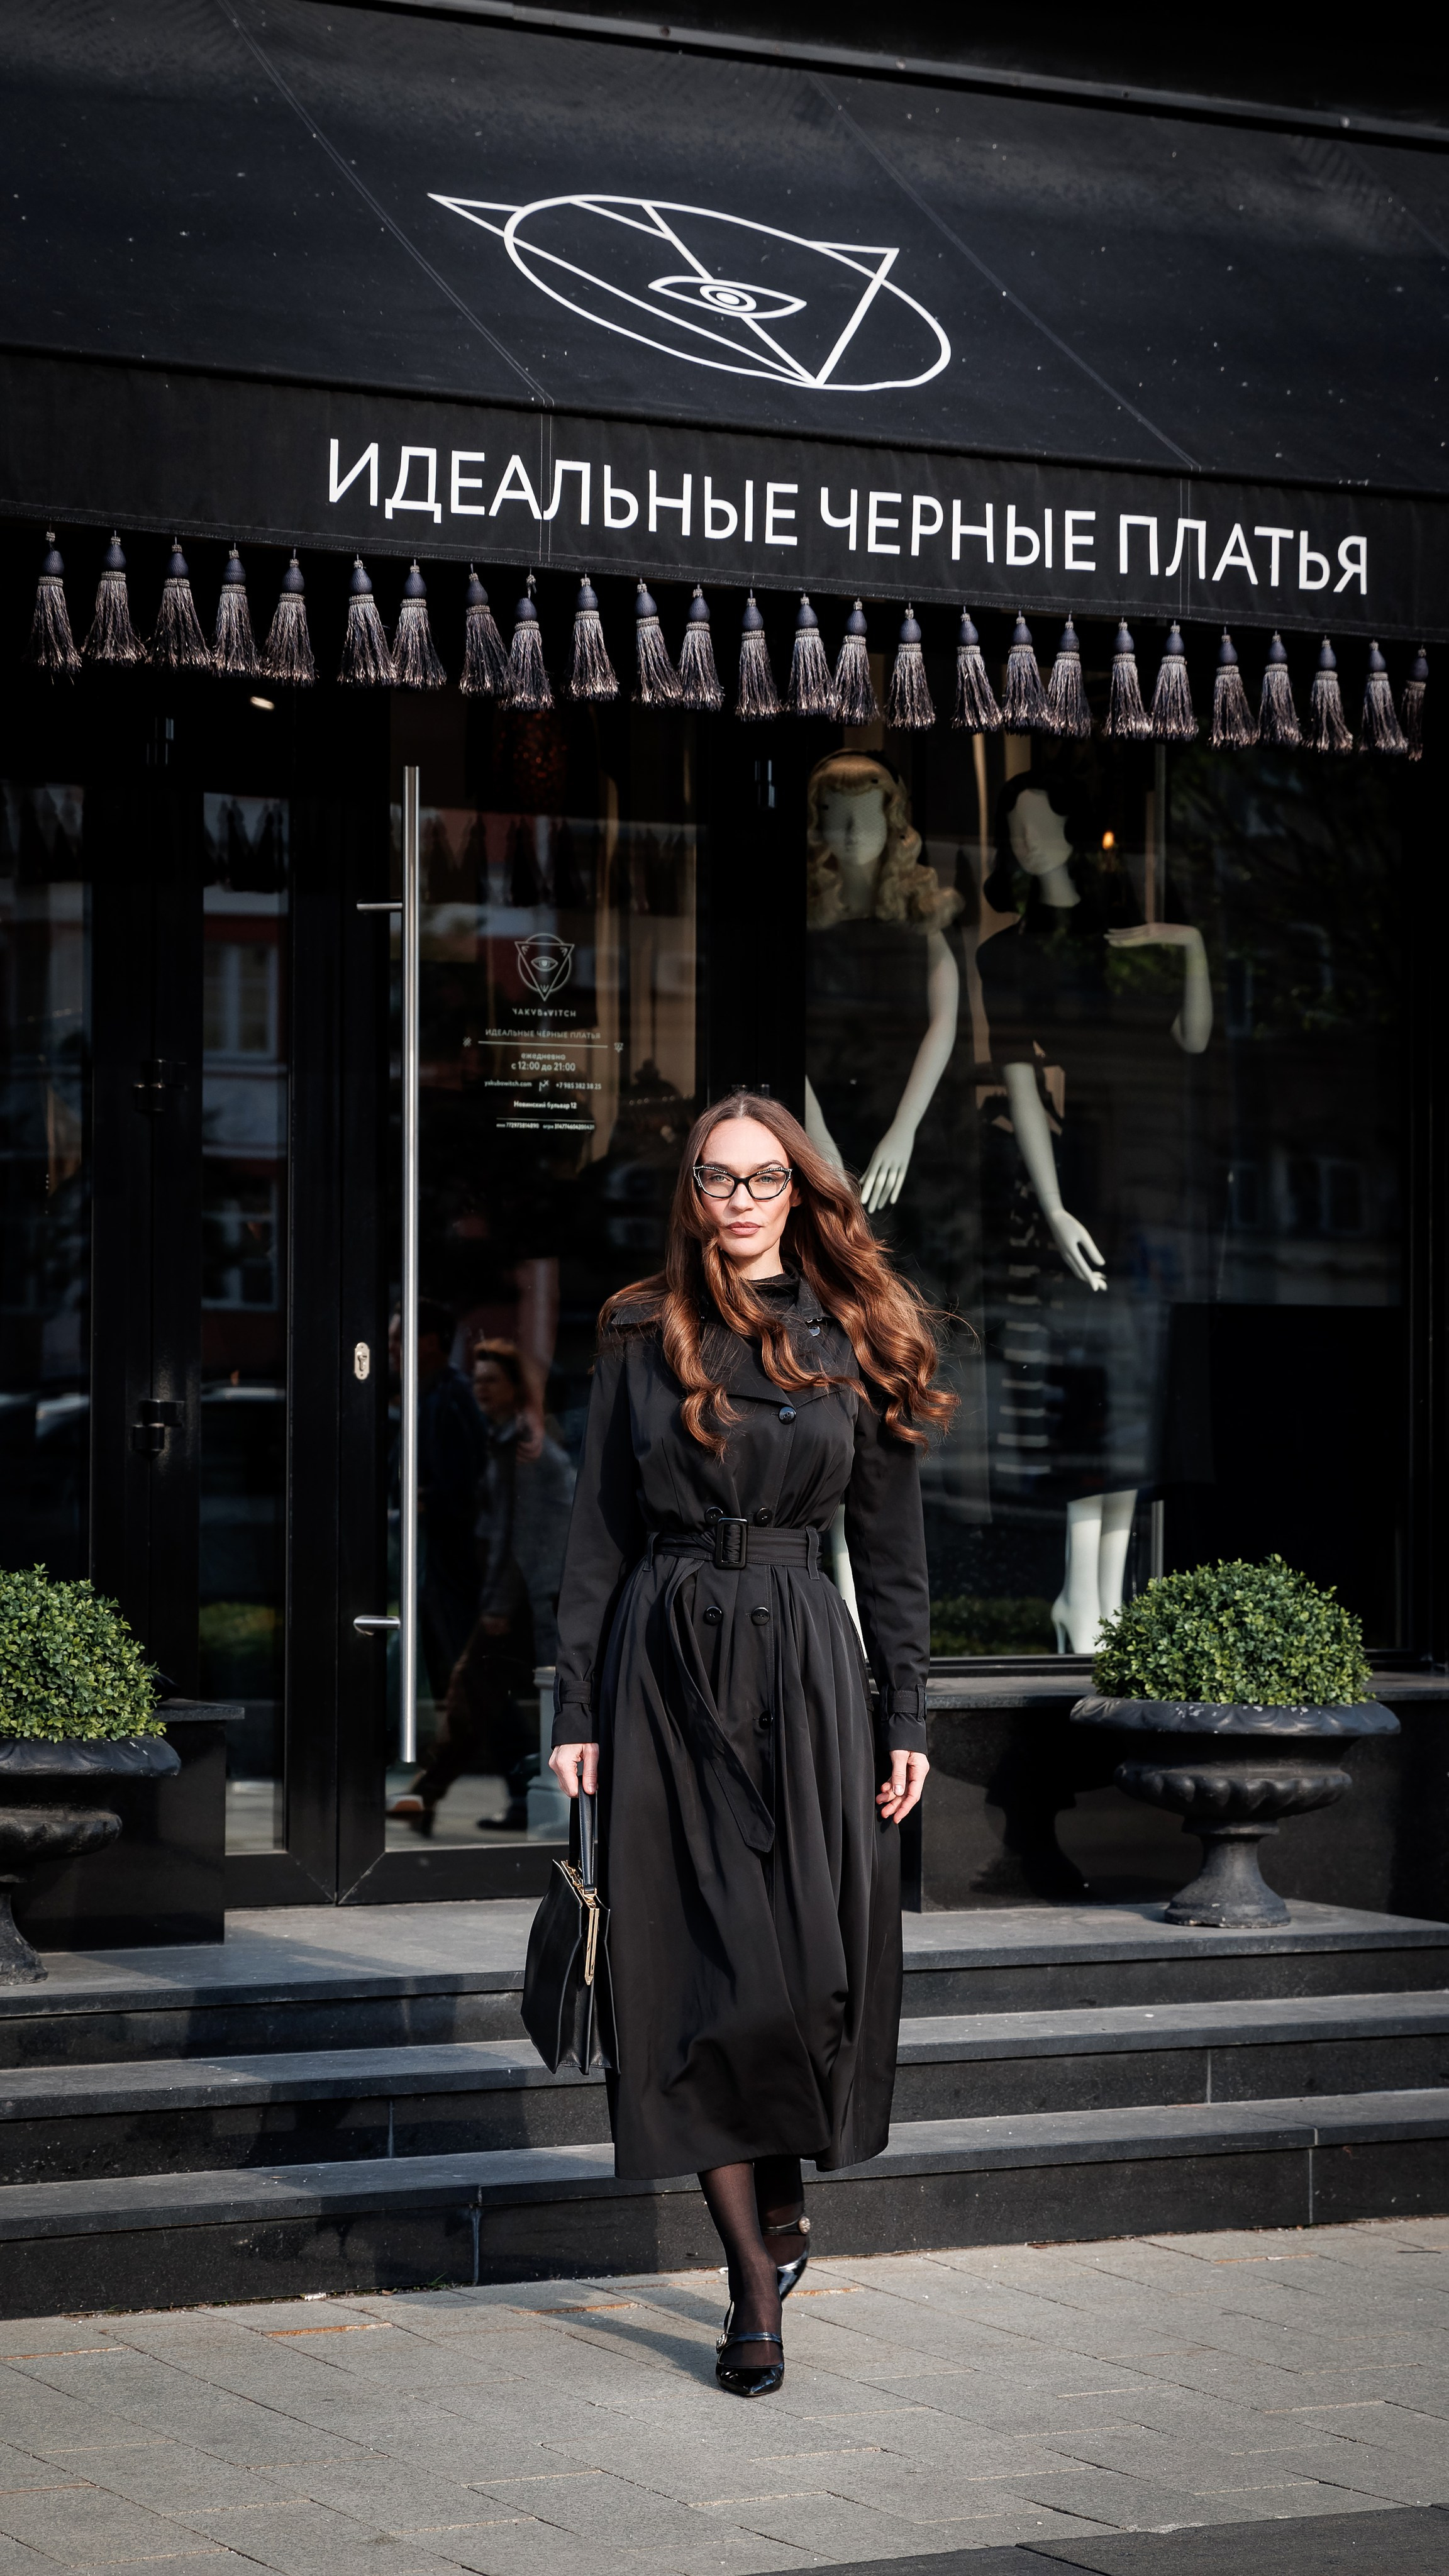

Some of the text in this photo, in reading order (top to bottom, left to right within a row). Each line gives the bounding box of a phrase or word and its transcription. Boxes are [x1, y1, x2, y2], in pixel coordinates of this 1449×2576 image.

[329, 438, 1367, 595] ИДЕАЛЬНЫЕ ЧЕРНЫЕ ПЛАТЬЯ
[485, 1028, 535, 1038] ИДЕАЛЬНЫЕ
[569, 1031, 601, 1040] ПЛАТЬЯ
[521, 1052, 566, 1060] ежедневно
[518, 1060, 540, 1071] 12:00
[541, 1063, 553, 1072] до
[553, 1062, 576, 1072] 21:00
[513, 1100, 547, 1109] Новинский
[547, 1101, 570, 1110] бульвар
